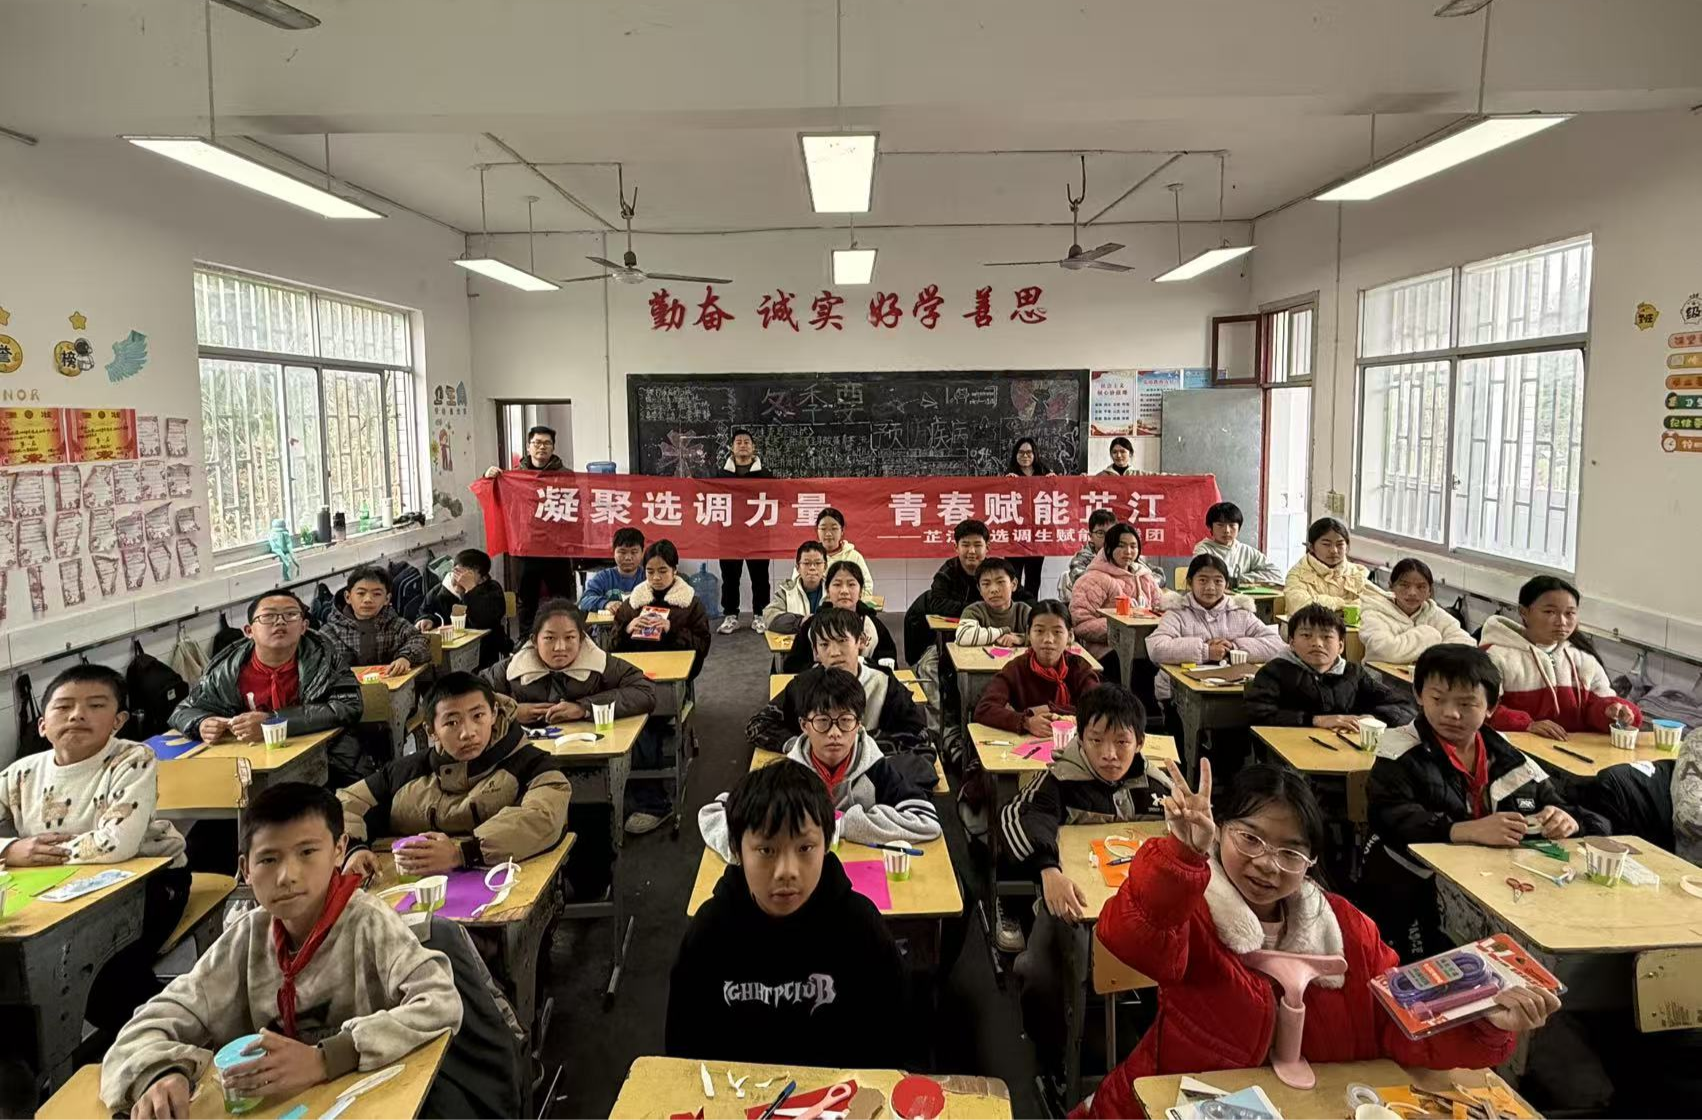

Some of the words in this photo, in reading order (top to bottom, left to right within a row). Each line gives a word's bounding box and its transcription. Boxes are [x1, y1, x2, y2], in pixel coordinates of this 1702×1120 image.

[649, 285, 735, 332] 勤奋
[757, 289, 844, 332] 诚实
[867, 284, 944, 329] 好学
[963, 286, 1047, 328] 善思
[1686, 306, 1701, 319] 级
[61, 350, 77, 368] 榜
[3, 389, 40, 401] NOR
[534, 486, 832, 527] 凝聚选调力量
